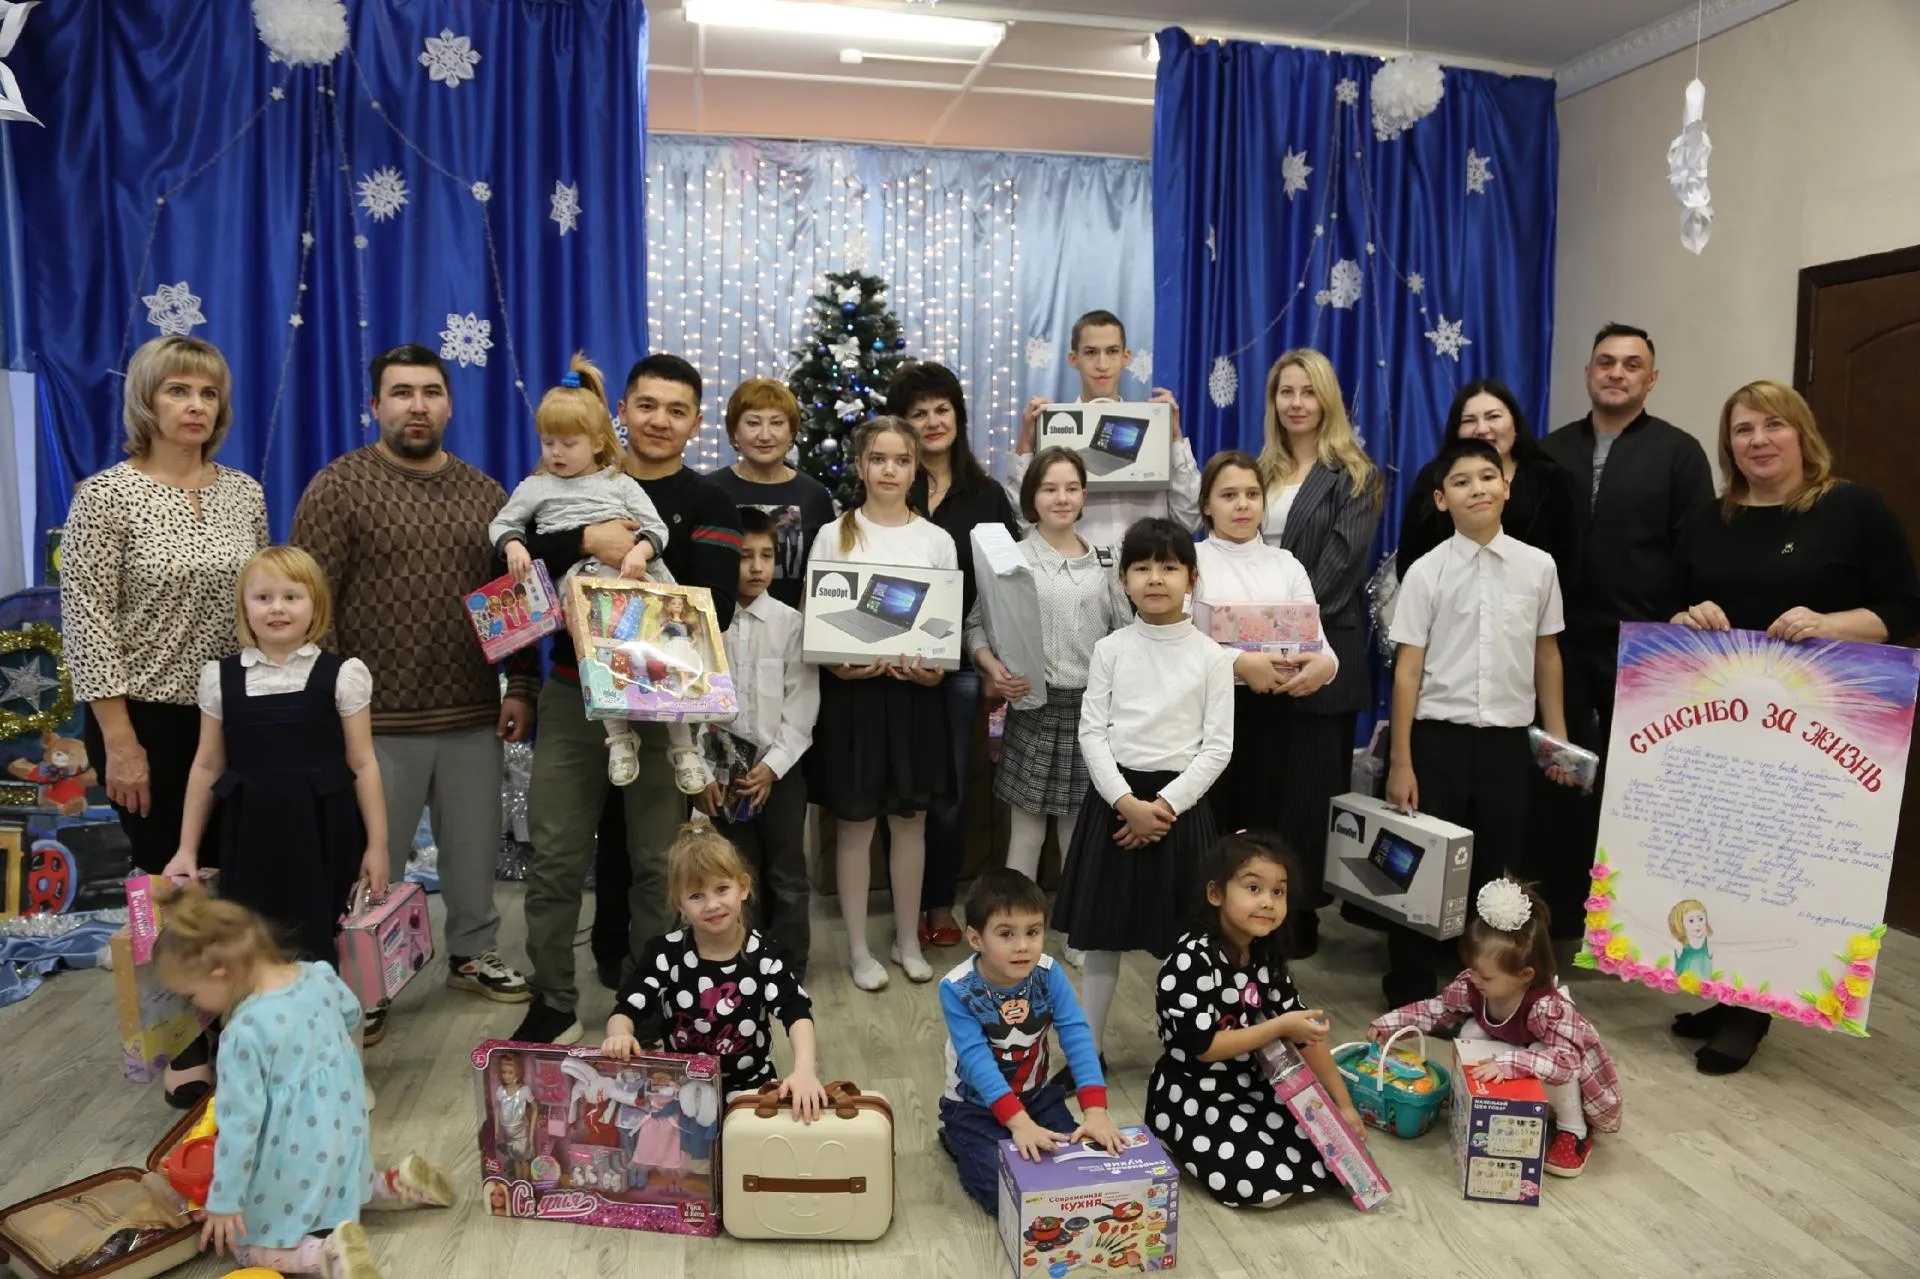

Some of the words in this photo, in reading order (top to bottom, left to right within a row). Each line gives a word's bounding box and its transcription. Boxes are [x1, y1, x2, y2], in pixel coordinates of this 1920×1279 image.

[1049, 425, 1075, 435] ShopOpt
[818, 586, 849, 599] ShopOpt
[1629, 697, 1749, 754] СПАСИБО
[1761, 702, 1798, 734] ЗА
[1801, 719, 1883, 793] ЖИЗНЬ
[1060, 1199, 1102, 1213] КУХНЯ
